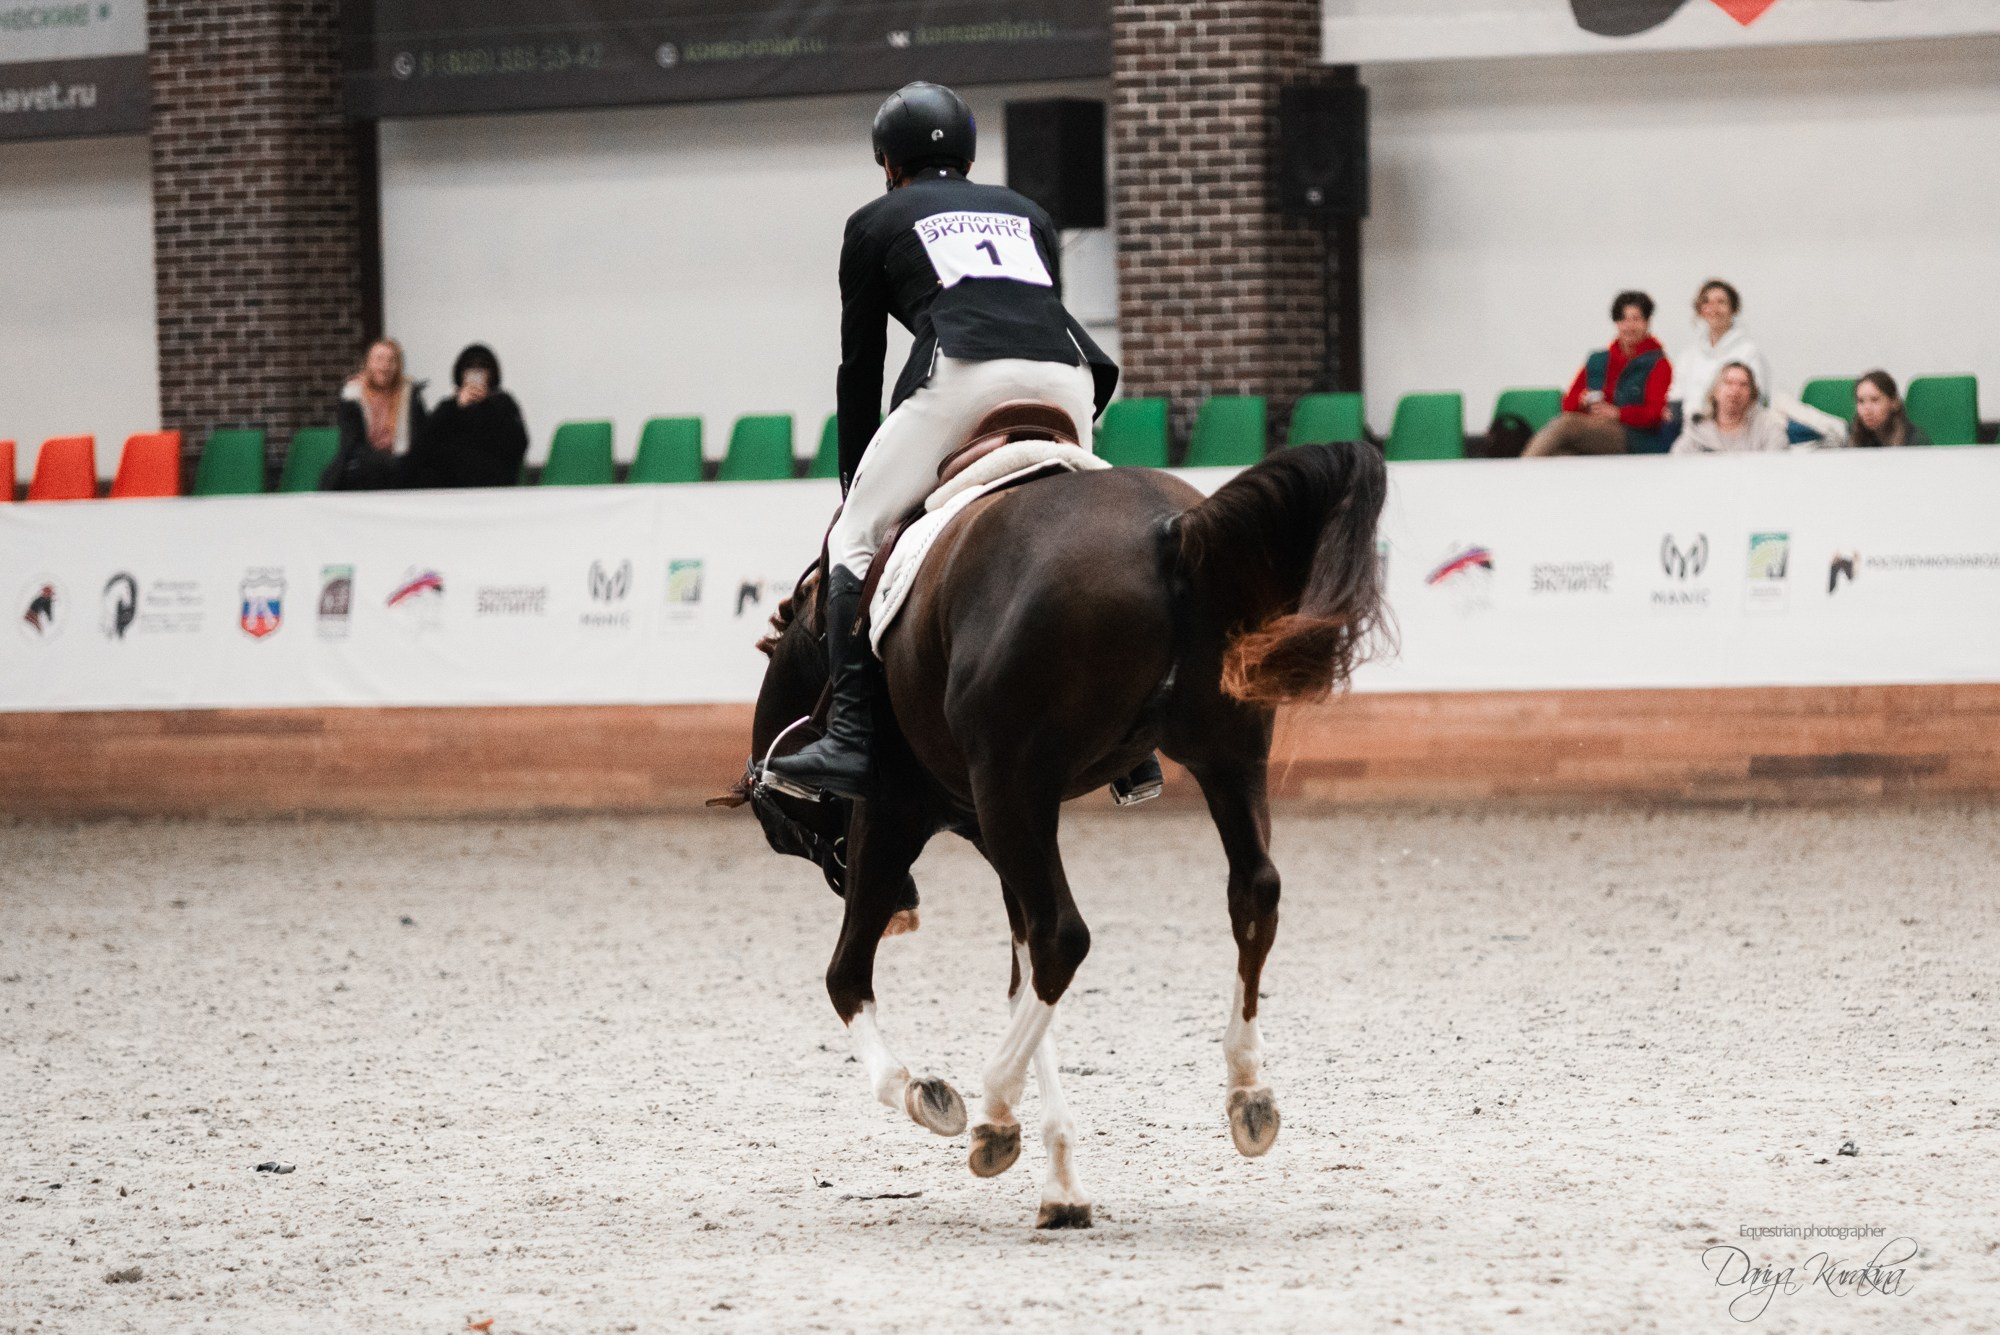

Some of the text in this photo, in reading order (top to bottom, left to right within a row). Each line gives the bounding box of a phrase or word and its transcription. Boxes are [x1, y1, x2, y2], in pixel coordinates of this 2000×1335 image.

[919, 214, 1022, 231] КРЫЛАТЫЙ
[923, 221, 1029, 244] ЭКЛИПС
[975, 239, 1002, 266] 1
